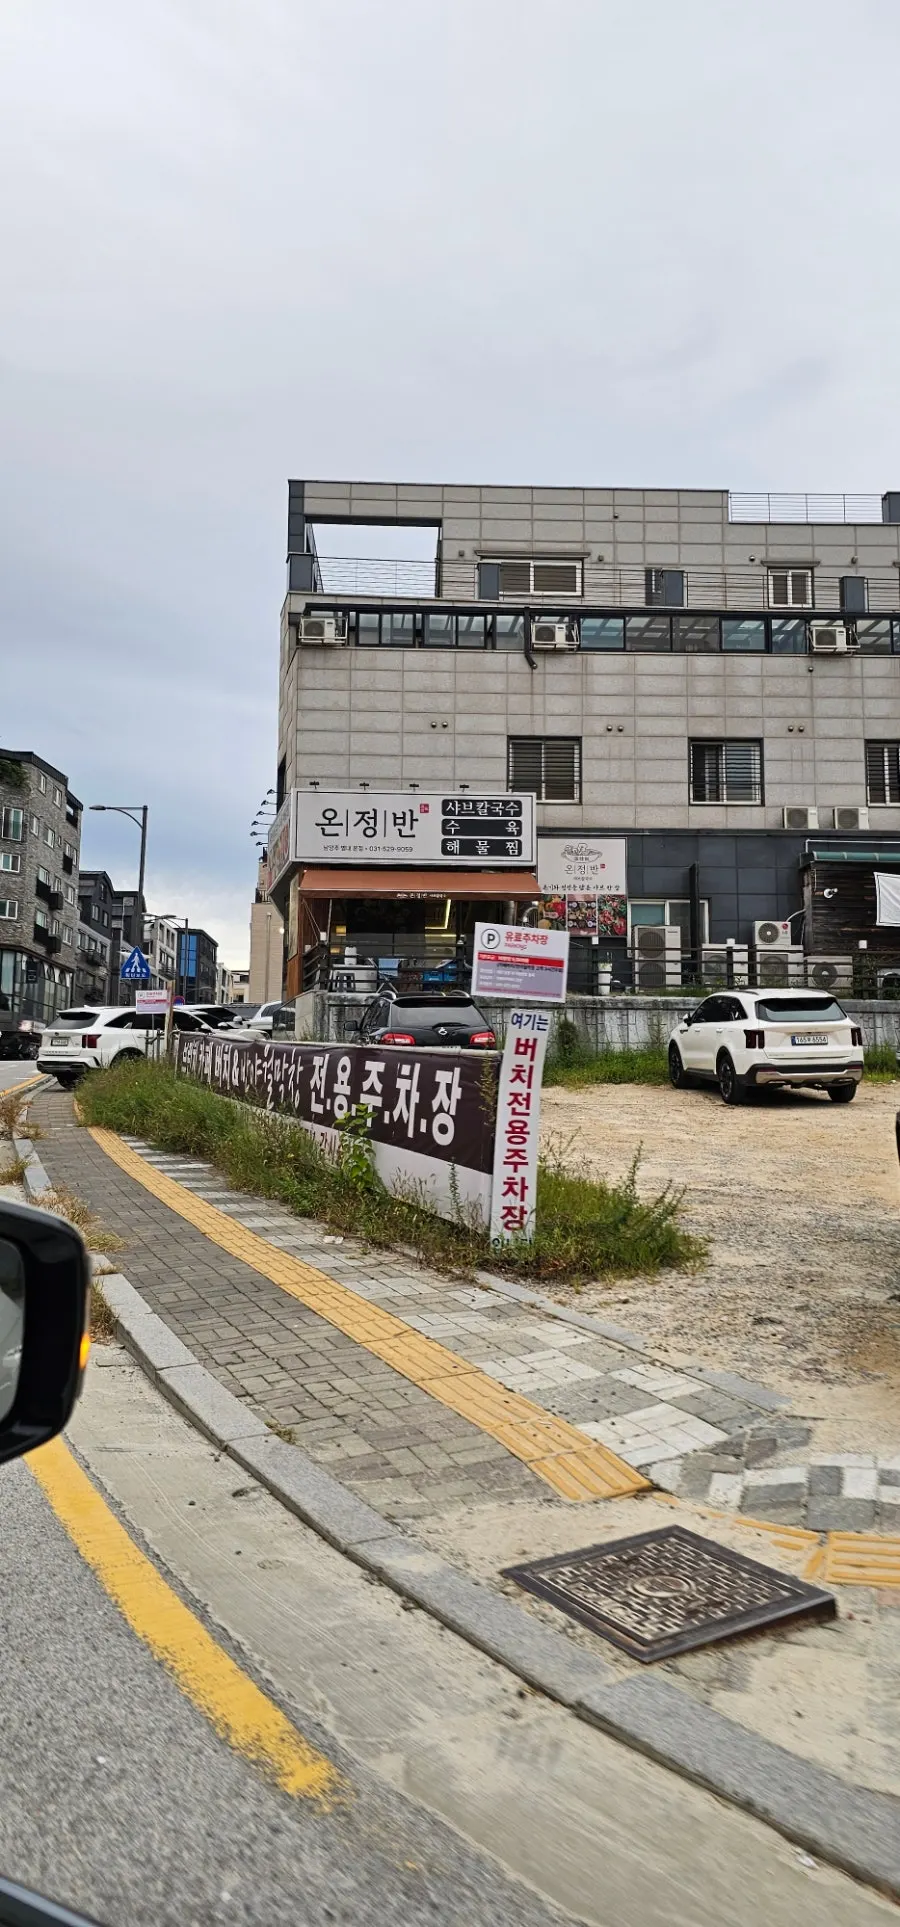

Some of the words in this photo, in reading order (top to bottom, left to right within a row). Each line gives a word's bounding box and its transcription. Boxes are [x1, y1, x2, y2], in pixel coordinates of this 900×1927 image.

[446, 800, 520, 816] 샤브칼국수
[369, 845, 413, 853] 031-529-9059
[505, 931, 549, 946] 유료주차장
[511, 1013, 549, 1031] 여기는
[215, 1043, 233, 1091] 버치
[231, 1048, 240, 1087] &
